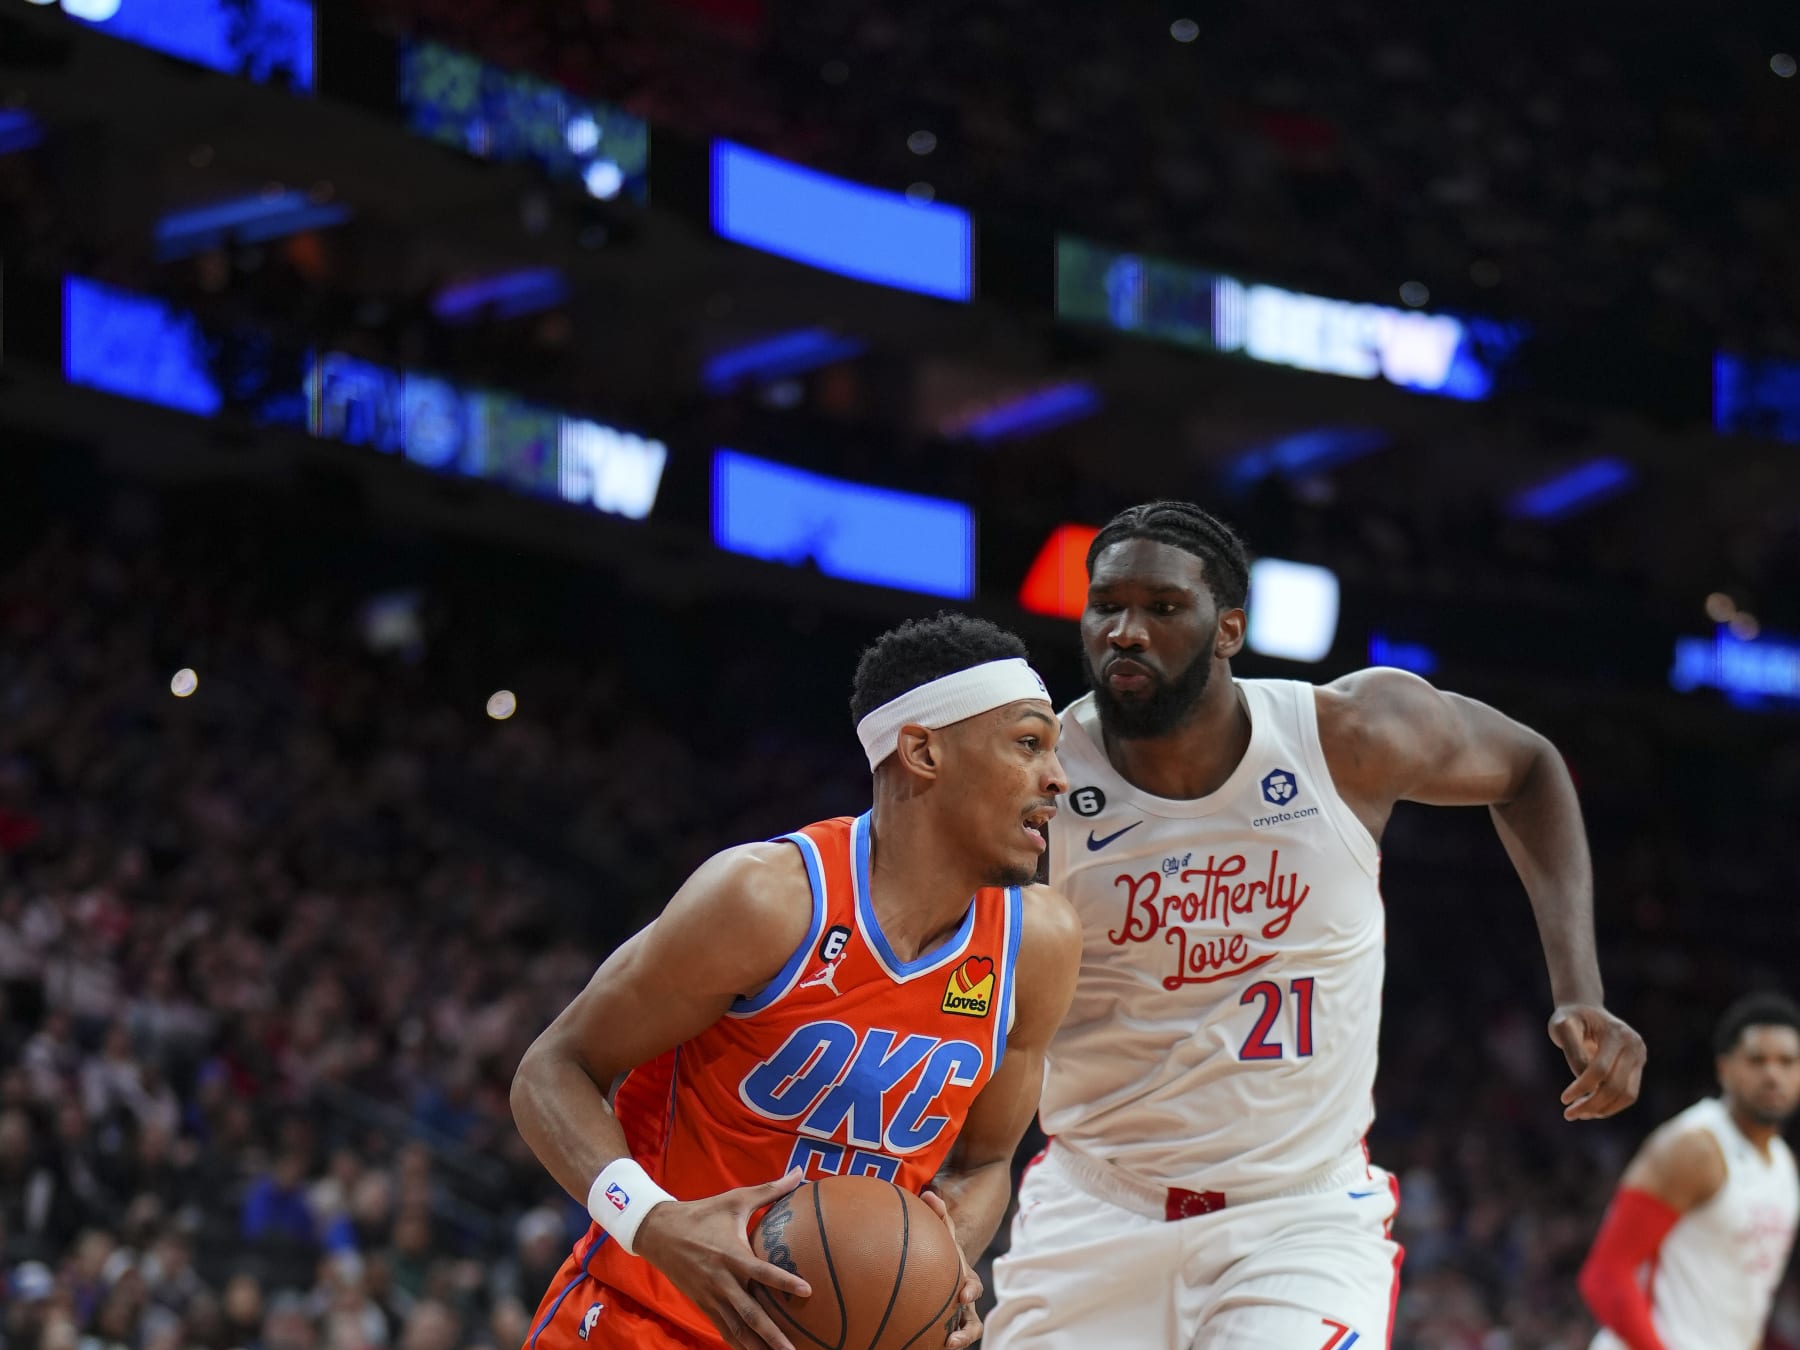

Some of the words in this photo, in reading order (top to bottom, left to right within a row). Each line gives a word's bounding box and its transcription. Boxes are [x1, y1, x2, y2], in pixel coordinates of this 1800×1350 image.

[1076, 790, 1099, 814] 6
[1252, 806, 1320, 828] crypto.com
[1108, 850, 1310, 945] Brotherly
[824, 931, 848, 960] 6
[1163, 926, 1279, 991] Love
[1238, 977, 1315, 1061] 21
[738, 1020, 984, 1153] OKC
